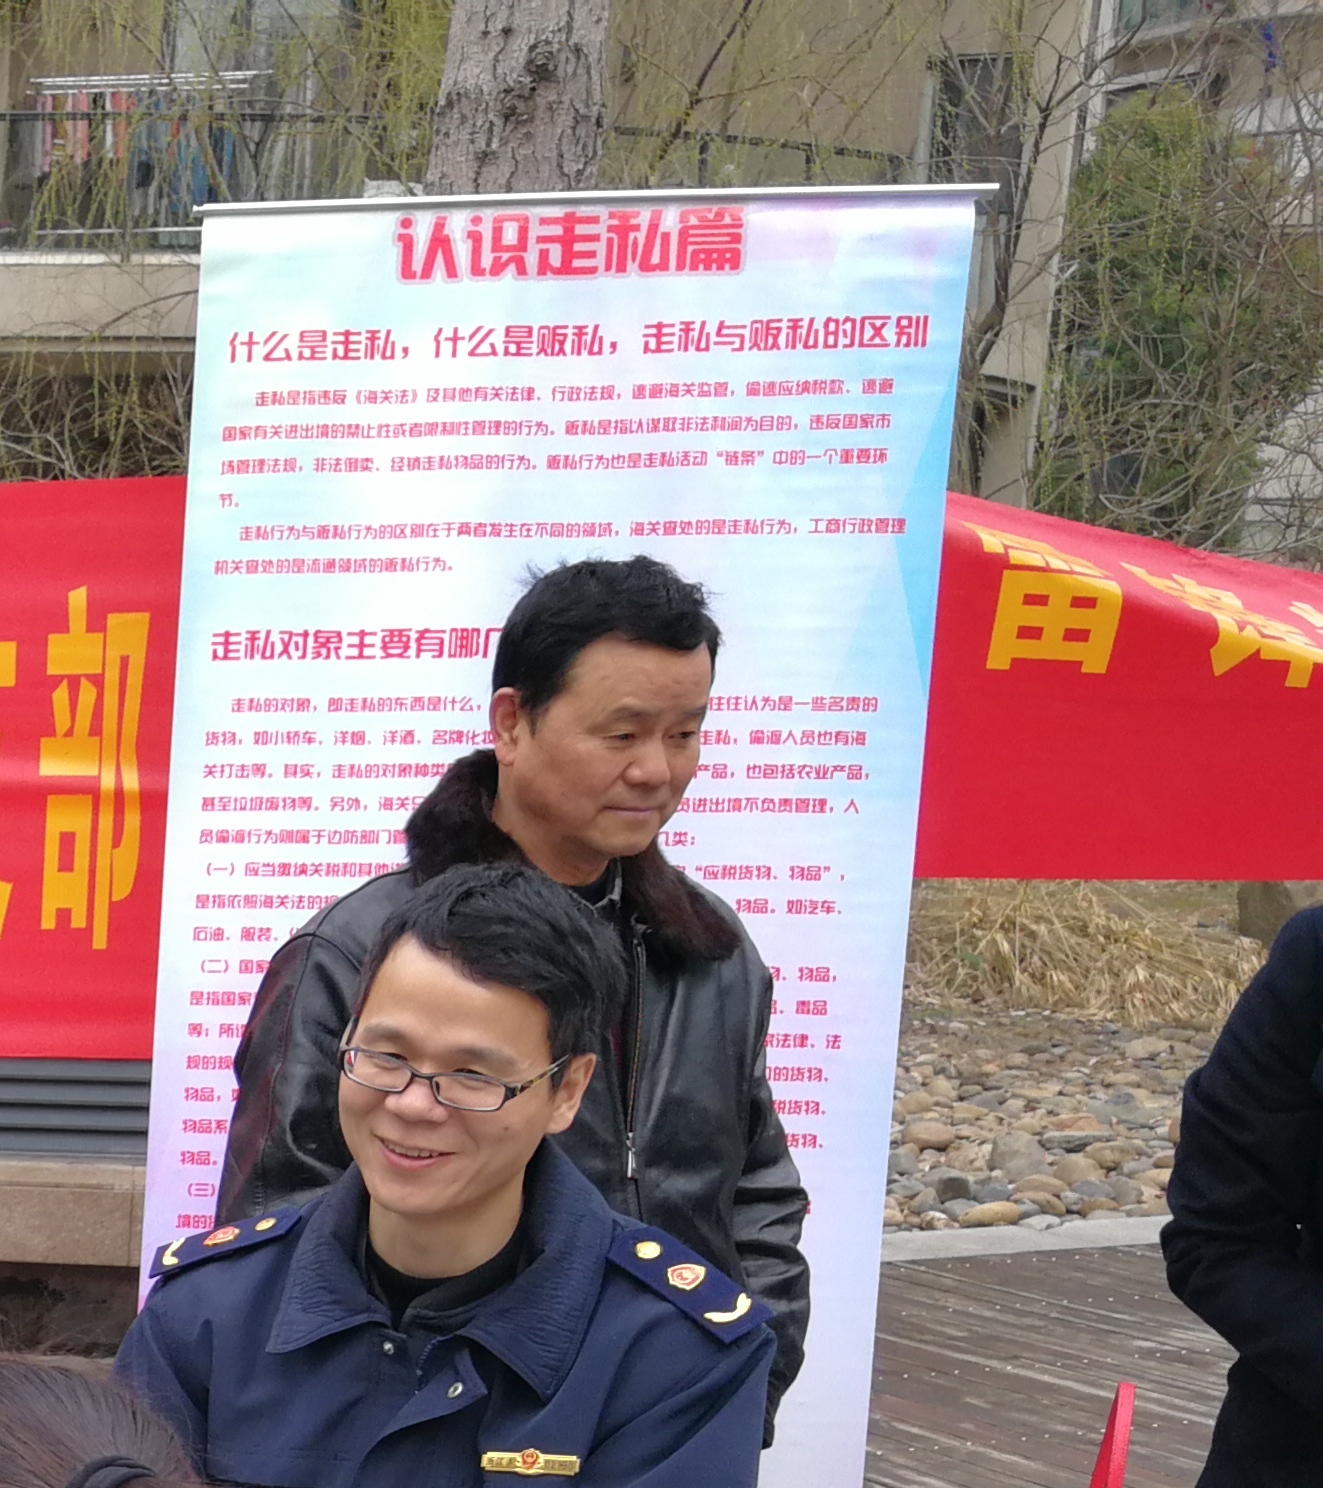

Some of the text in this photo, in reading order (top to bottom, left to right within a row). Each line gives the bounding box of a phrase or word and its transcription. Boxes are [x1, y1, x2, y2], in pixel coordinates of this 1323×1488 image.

[398, 208, 744, 283] 认识走私篇
[219, 495, 241, 510] 节。
[203, 765, 452, 782] 关打击等。其实，走私的对象种类
[736, 900, 843, 916] 物品。如汽车、
[189, 992, 258, 1008] 是指国家
[180, 1152, 219, 1168] 物品。
[187, 1184, 217, 1200] （三）
